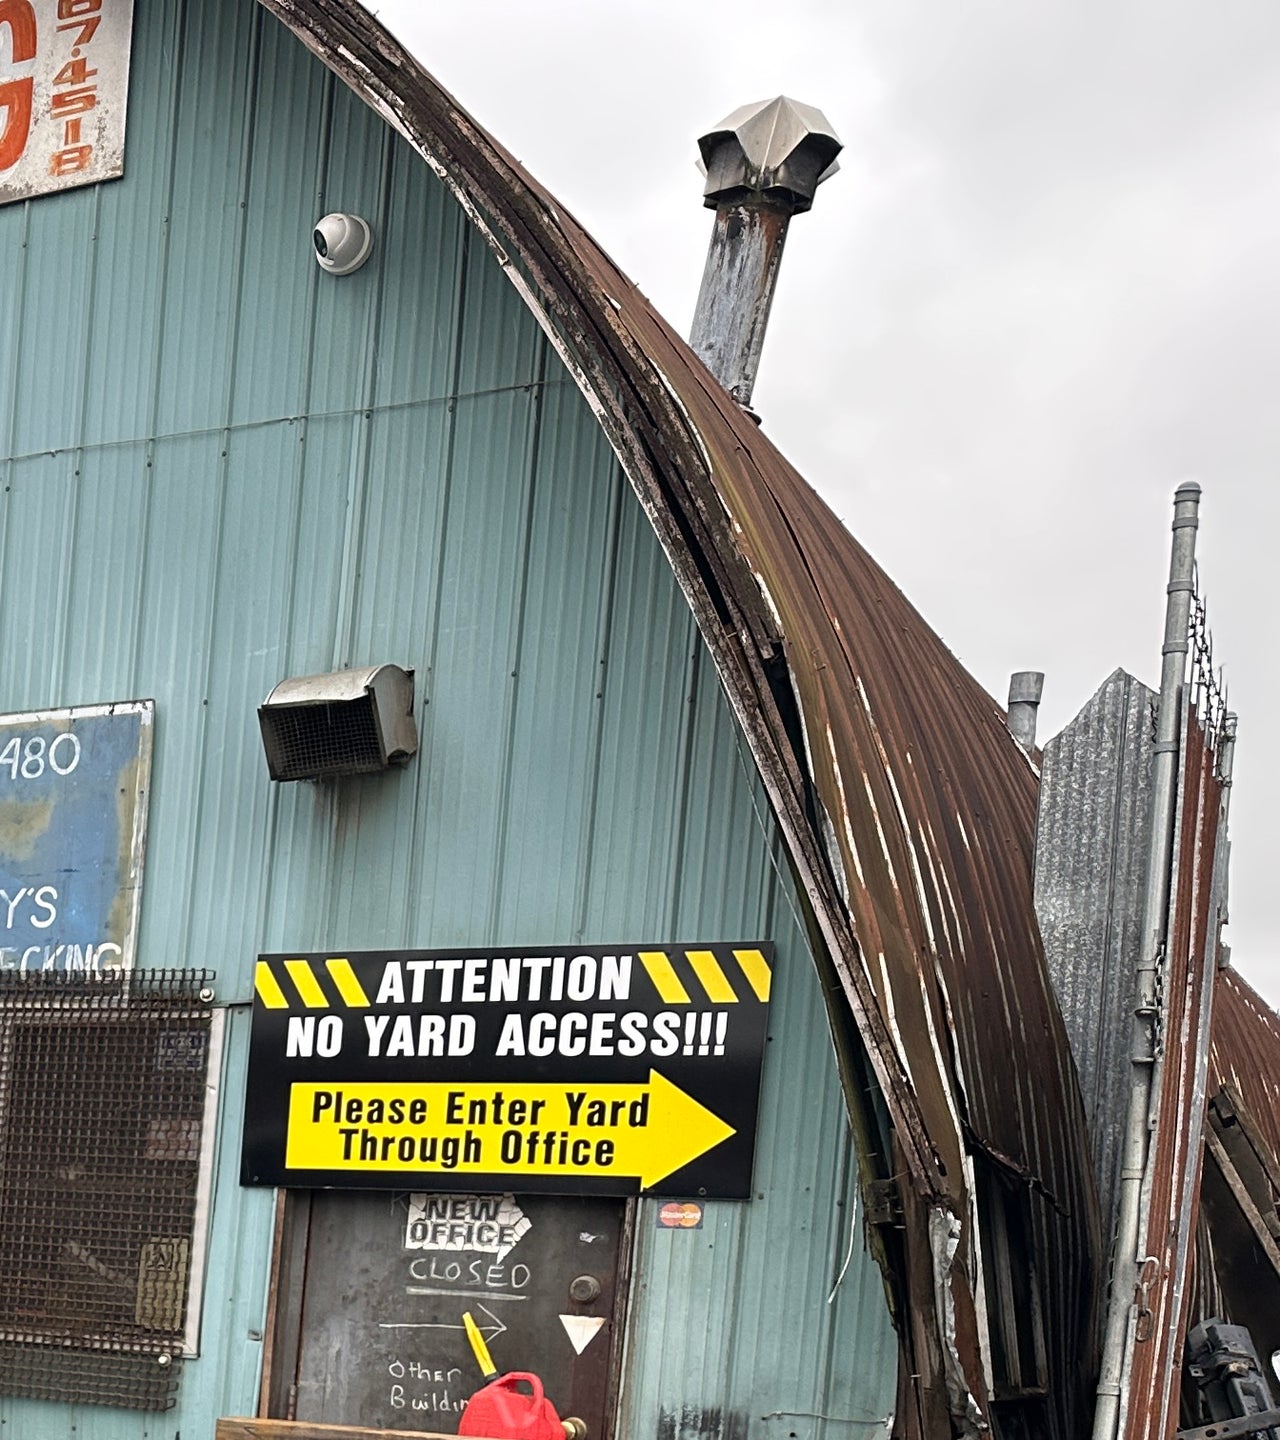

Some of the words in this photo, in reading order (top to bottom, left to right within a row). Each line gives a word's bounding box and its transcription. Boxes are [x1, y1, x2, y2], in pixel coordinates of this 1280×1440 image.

[375, 955, 634, 1005] ATTENTION
[286, 1014, 344, 1058] NO
[366, 1013, 477, 1057] YARD
[495, 1010, 729, 1057] ACCESS!!!
[311, 1090, 428, 1125] Please
[445, 1091, 546, 1127] Enter
[565, 1091, 649, 1128] Yard
[338, 1128, 482, 1170] Through
[500, 1130, 615, 1167] Office
[426, 1199, 501, 1221] NEW
[409, 1220, 517, 1247] OFFICE
[409, 1257, 531, 1288] CLOSED
[390, 1384, 470, 1413] Buildin
